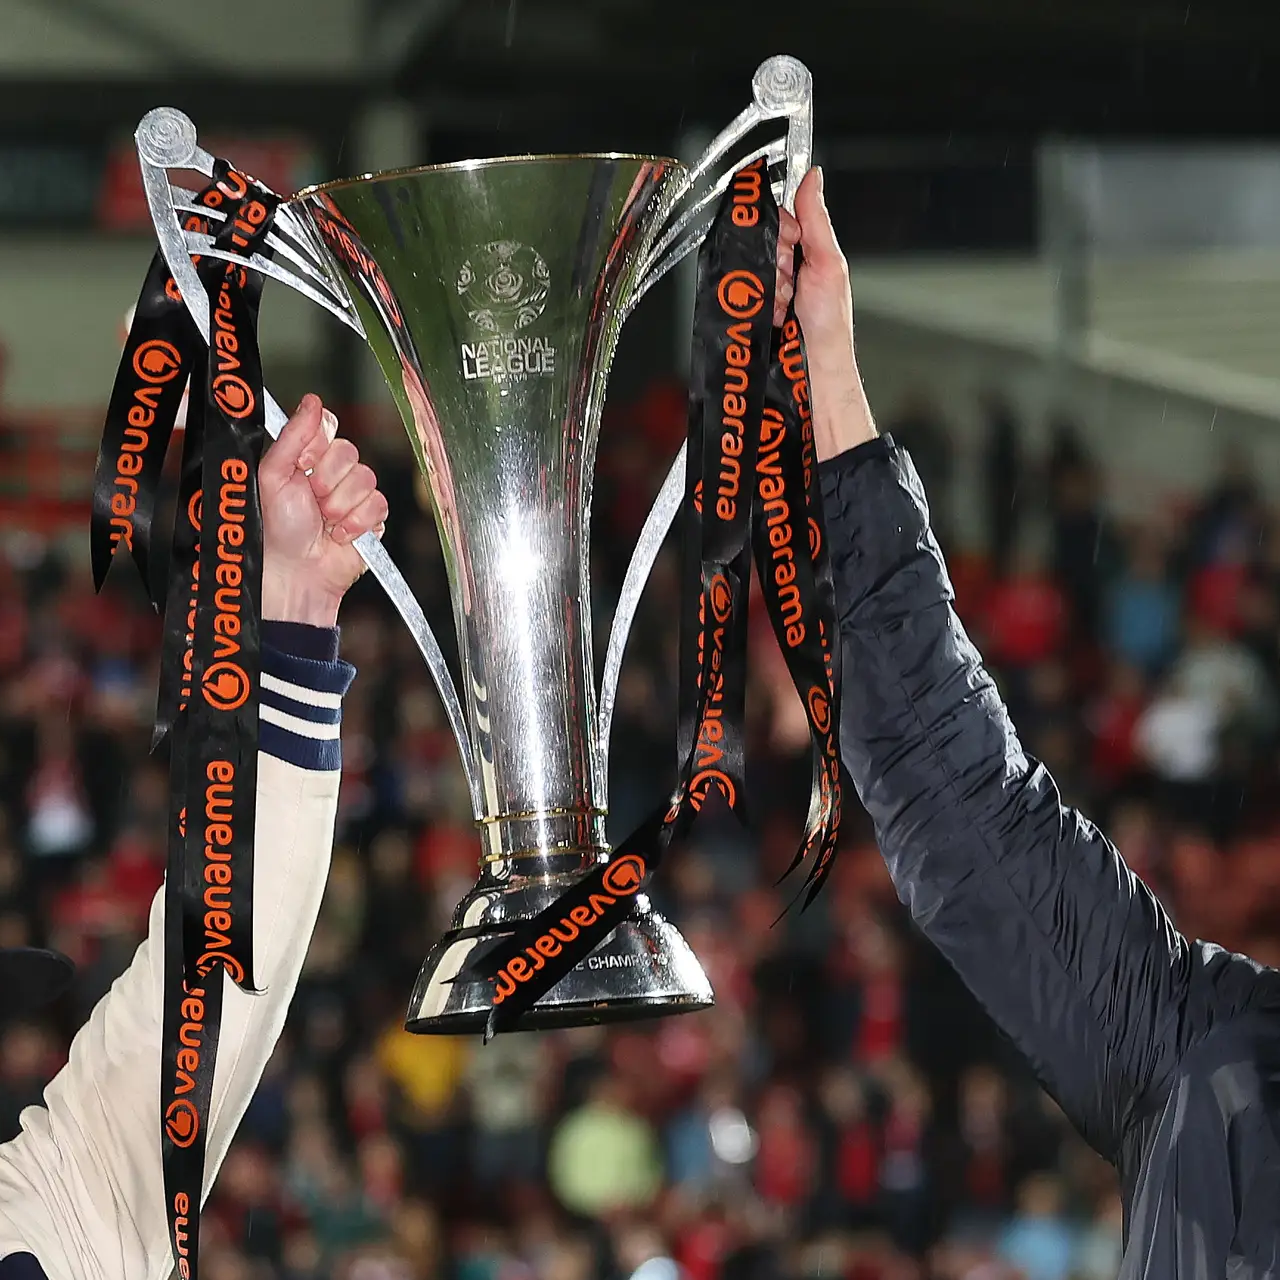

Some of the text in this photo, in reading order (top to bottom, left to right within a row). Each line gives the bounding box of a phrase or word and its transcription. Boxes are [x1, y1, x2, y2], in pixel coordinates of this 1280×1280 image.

[461, 336, 553, 360] NATIONAL
[462, 350, 554, 380] LEAGUE
[716, 322, 753, 521] vanarama
[109, 386, 159, 555] vanaram
[213, 458, 249, 657] vanarama
[755, 448, 806, 648] vanarama
[203, 760, 235, 950] vanarama
[491, 894, 617, 1005] vanaram
